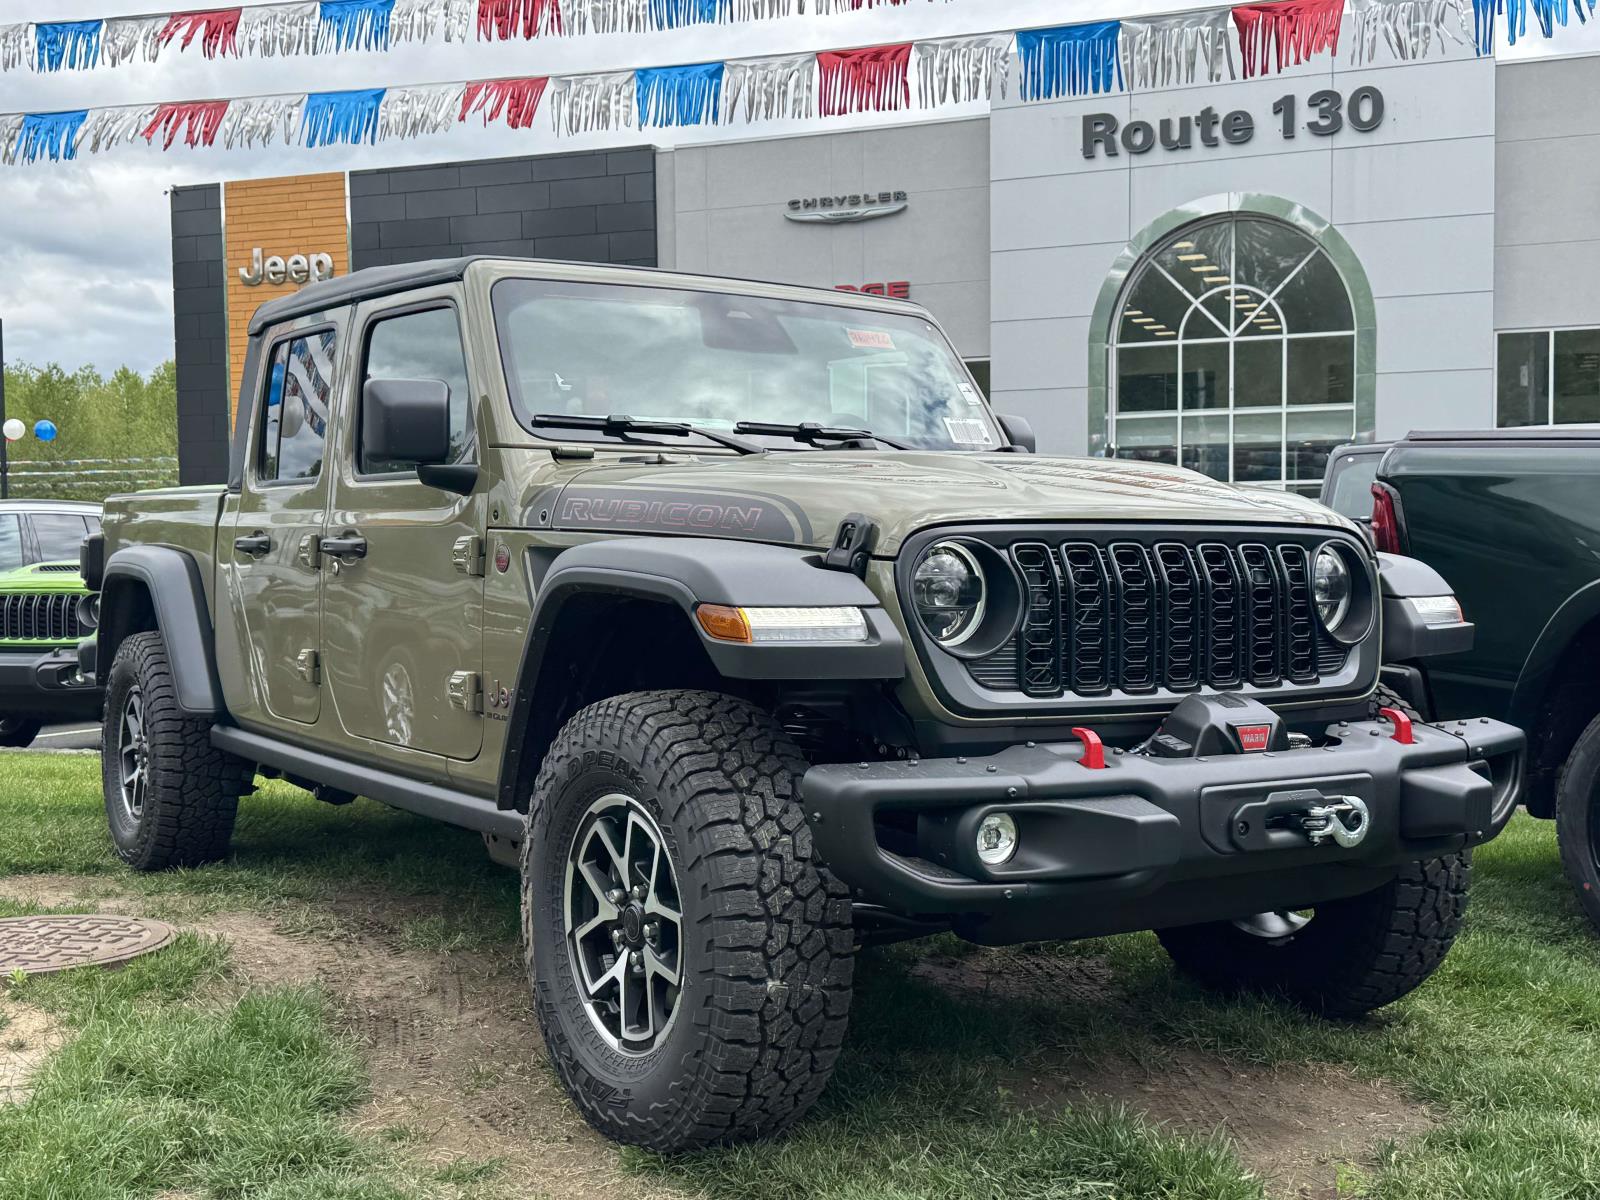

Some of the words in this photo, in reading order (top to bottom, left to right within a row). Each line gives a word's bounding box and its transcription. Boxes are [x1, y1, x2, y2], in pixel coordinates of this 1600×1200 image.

[1081, 106, 1254, 158] Route
[1272, 85, 1384, 139] 130
[787, 190, 907, 210] CHRYSLER
[238, 247, 334, 286] Jeep
[561, 498, 763, 531] RUBICON
[488, 679, 515, 708] Je
